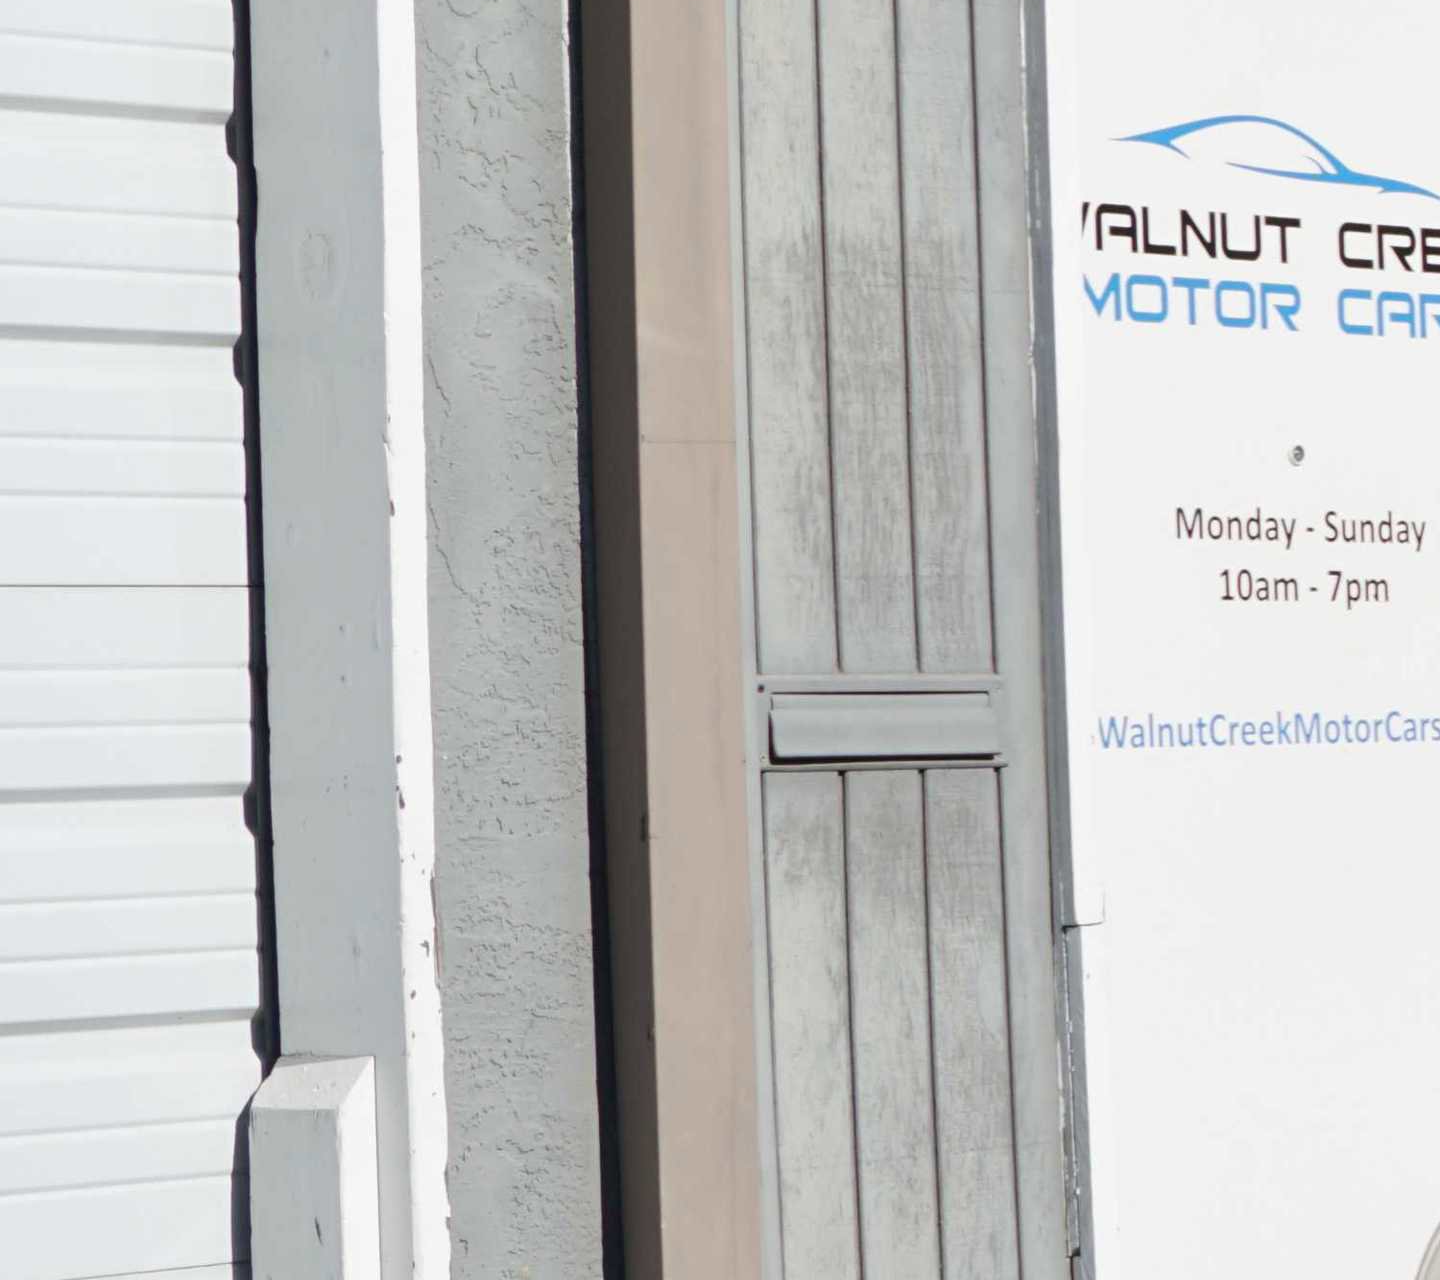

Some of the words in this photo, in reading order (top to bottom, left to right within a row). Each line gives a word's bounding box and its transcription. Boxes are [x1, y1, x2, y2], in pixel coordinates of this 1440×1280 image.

[1081, 201, 1302, 264] ALNUT
[1082, 272, 1300, 331] MOTOR
[1174, 506, 1296, 550] Monday
[1324, 510, 1427, 552] Sunday
[1219, 568, 1300, 603] 10am
[1327, 570, 1390, 610] 7pm
